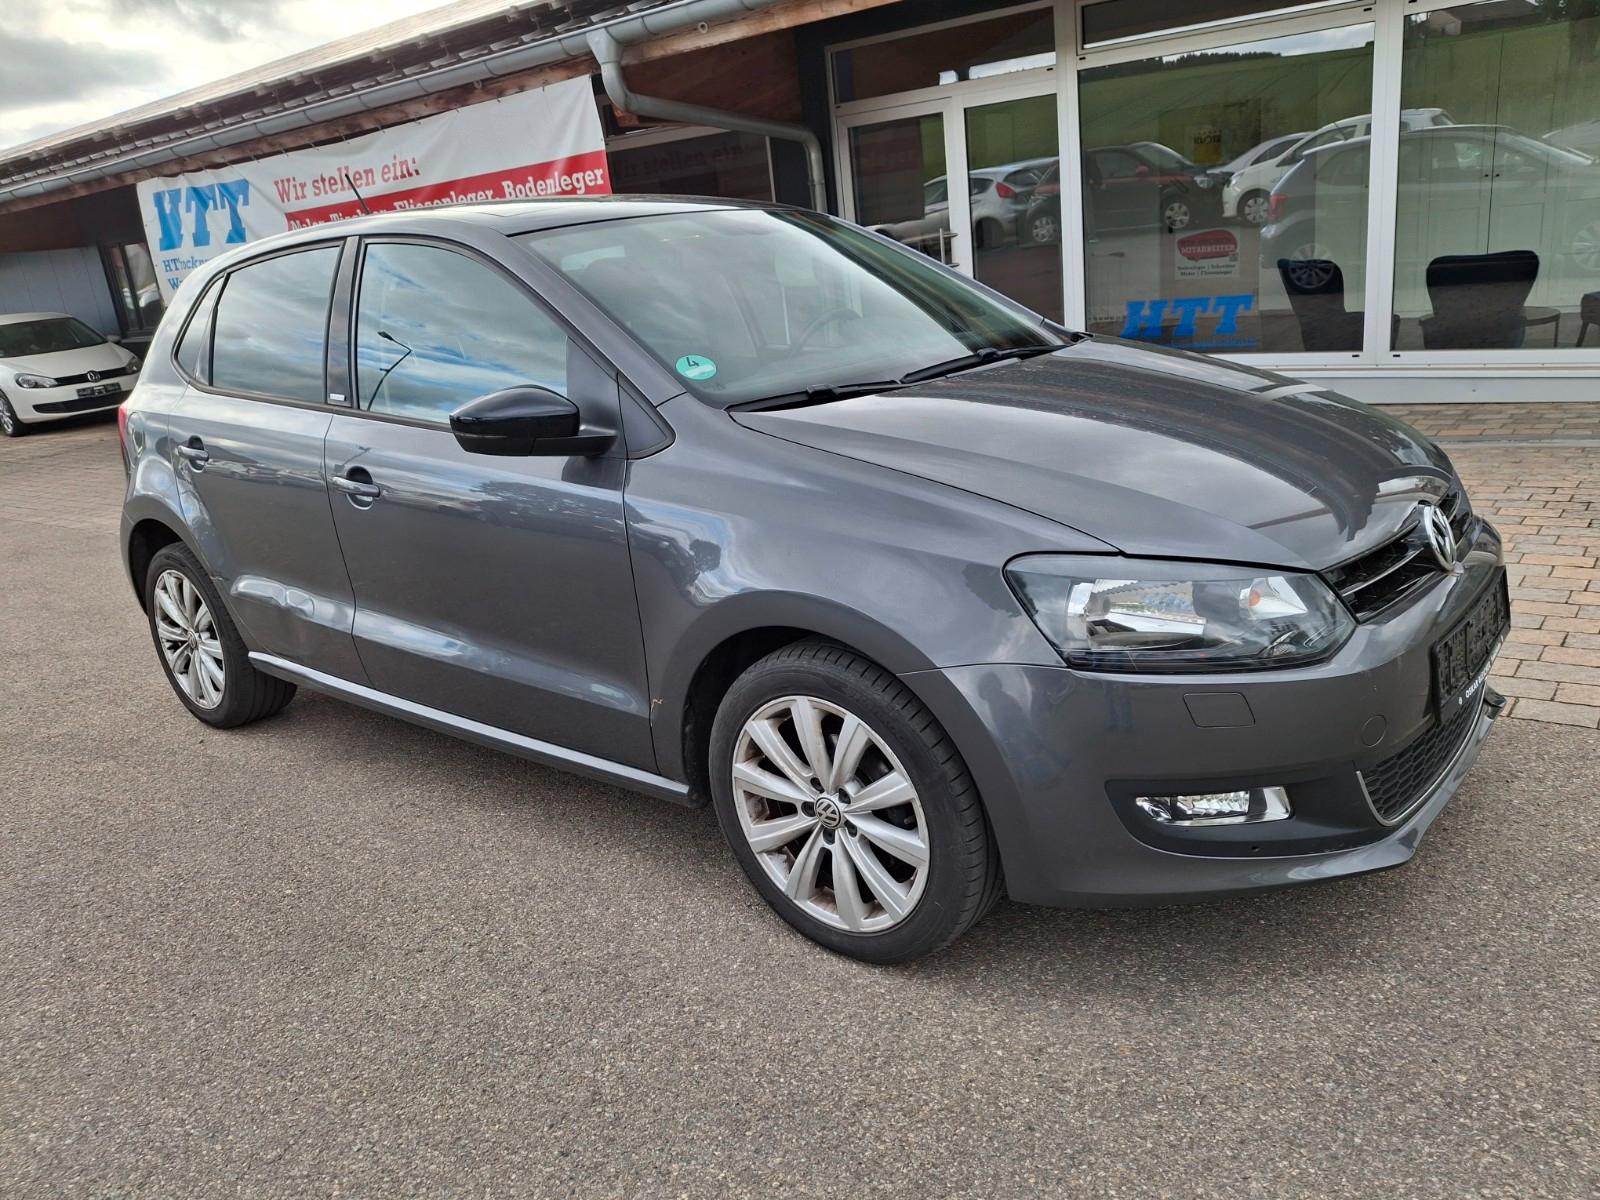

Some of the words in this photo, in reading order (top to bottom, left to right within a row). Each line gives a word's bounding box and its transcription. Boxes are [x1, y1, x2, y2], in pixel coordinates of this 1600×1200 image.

[274, 176, 307, 203] Wir
[312, 165, 376, 197] stellen
[381, 154, 421, 183] ein:
[502, 168, 604, 200] Bodenleger
[1120, 295, 1256, 338] HTT
[686, 356, 700, 367] 4
